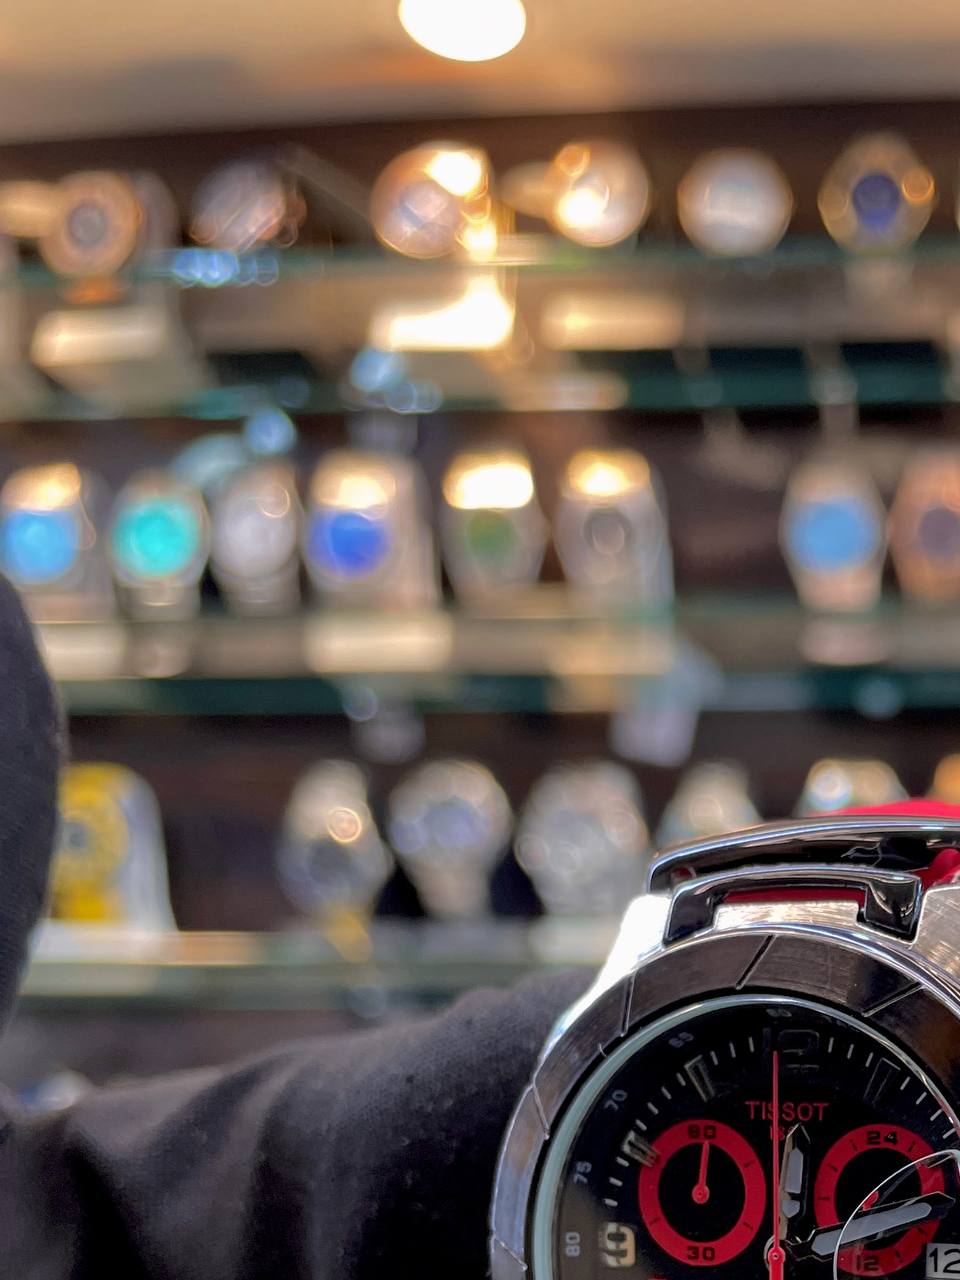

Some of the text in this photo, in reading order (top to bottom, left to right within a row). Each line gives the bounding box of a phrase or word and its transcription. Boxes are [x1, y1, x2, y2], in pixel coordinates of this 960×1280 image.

[745, 1101, 829, 1121] TISSOT
[866, 1131, 898, 1145] 24
[573, 1161, 592, 1184] 75
[566, 1232, 580, 1257] 80
[605, 1222, 636, 1267] 9
[687, 1246, 715, 1260] 30
[856, 1255, 879, 1271] 12
